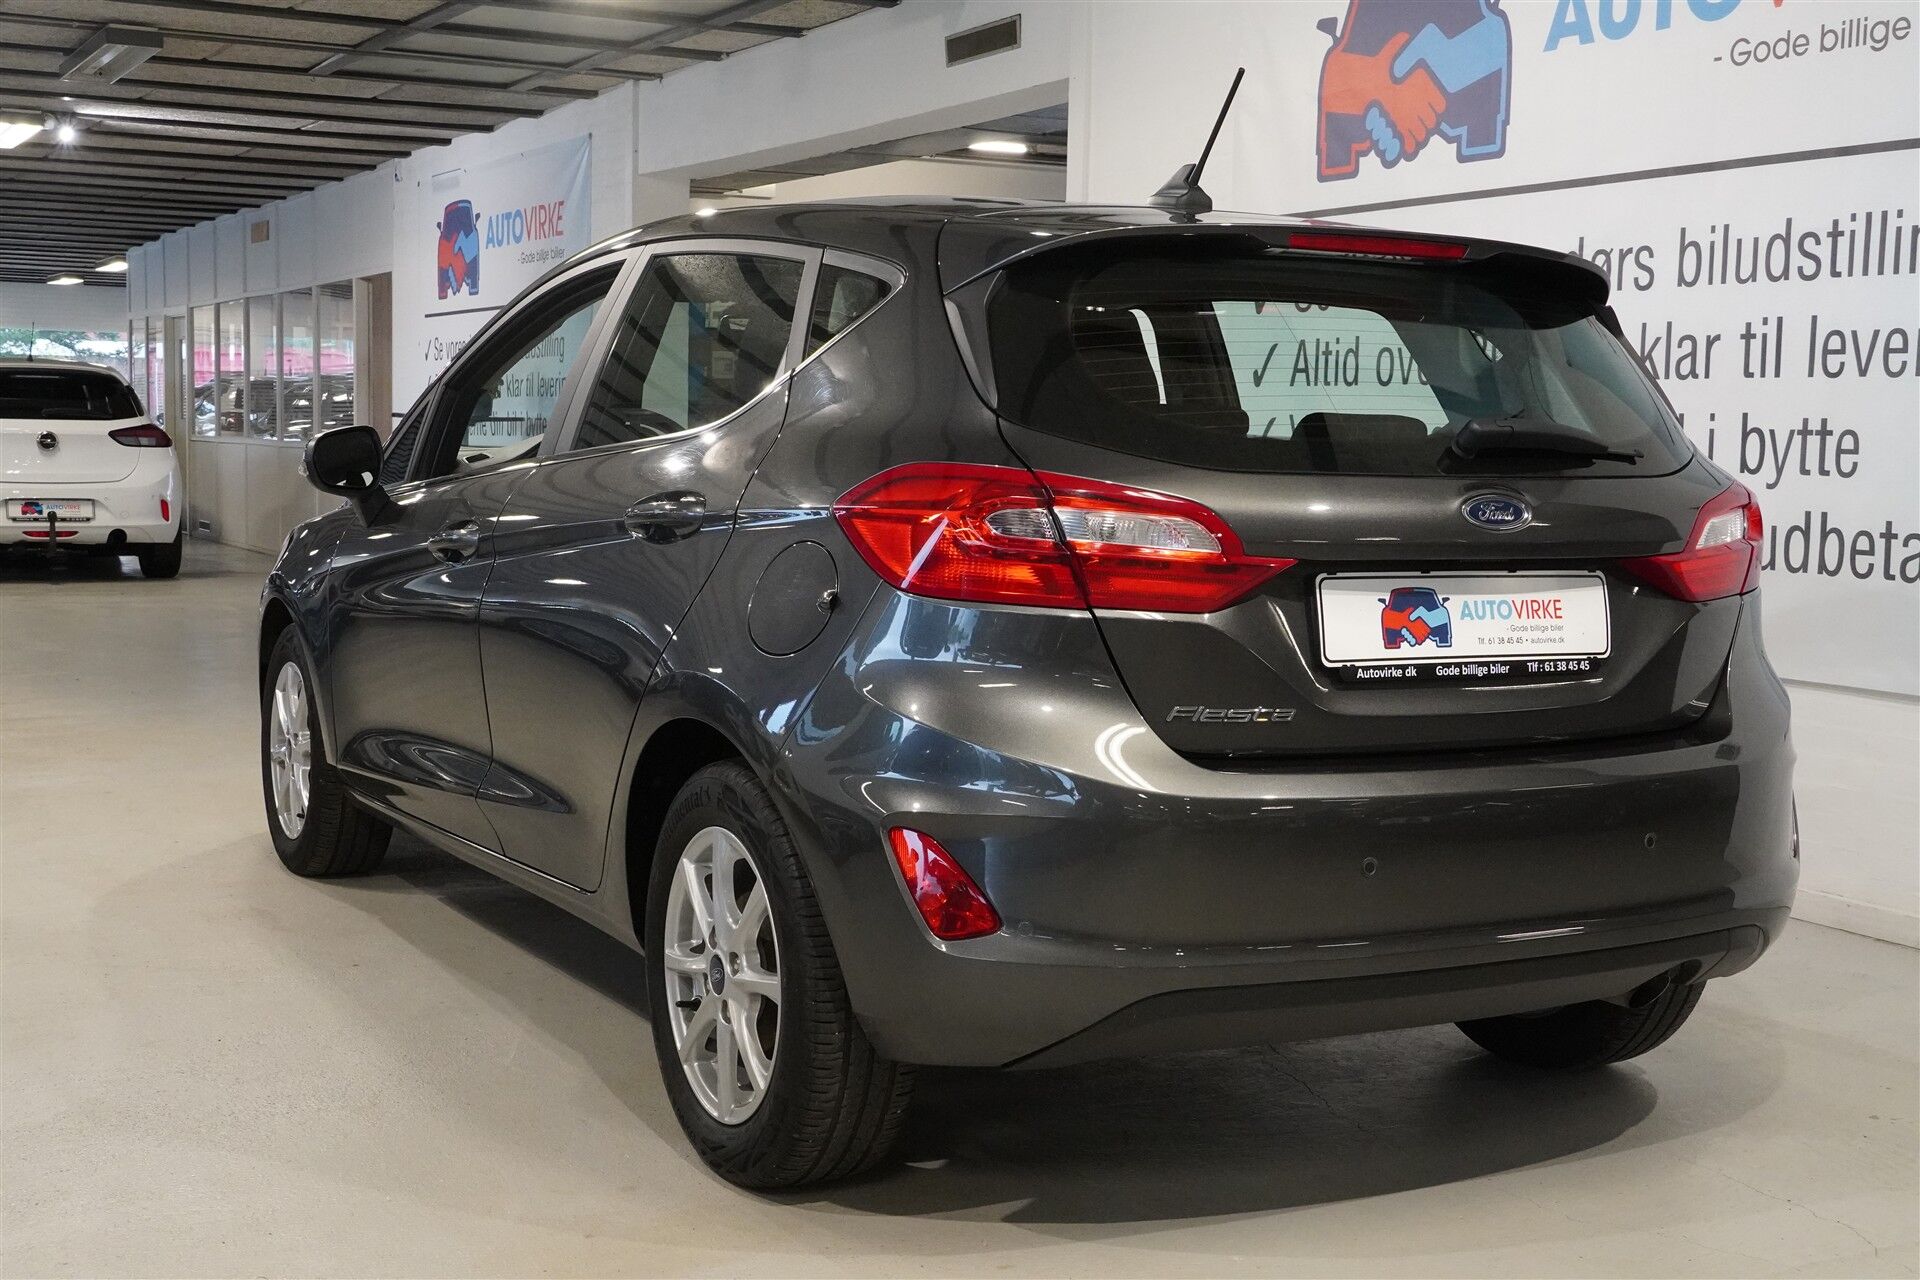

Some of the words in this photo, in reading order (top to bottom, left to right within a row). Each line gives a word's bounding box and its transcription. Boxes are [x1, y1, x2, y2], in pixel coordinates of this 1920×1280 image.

[1729, 30, 1810, 67] Gode
[1819, 16, 1912, 53] billige
[485, 200, 565, 250] AUTOVIRKE
[434, 337, 443, 361] Se
[1290, 335, 1360, 387] Altid
[1640, 320, 1721, 381] klar
[1739, 316, 1784, 379] til
[506, 374, 524, 398] klar
[525, 372, 534, 397] til
[1739, 411, 1860, 490] bytte
[1460, 599, 1563, 621] AUTOVIRKE
[1488, 637, 1496, 645] 61
[1497, 637, 1505, 645] 38
[1506, 637, 1515, 645] 45
[1515, 637, 1524, 645] 45
[1510, 624, 1529, 633] Gode
[1530, 624, 1549, 634] billige
[1550, 624, 1564, 632] biler
[1356, 667, 1403, 679] Autovirke
[1405, 666, 1418, 677] dk
[1436, 664, 1460, 676] Gode
[1461, 664, 1489, 676] billige
[1490, 663, 1510, 675] biler
[1544, 661, 1555, 672] 61
[1556, 661, 1567, 671] 38
[1568, 660, 1578, 671] 45
[1579, 660, 1590, 670] 45
[1165, 705, 1297, 722] Fiesta
